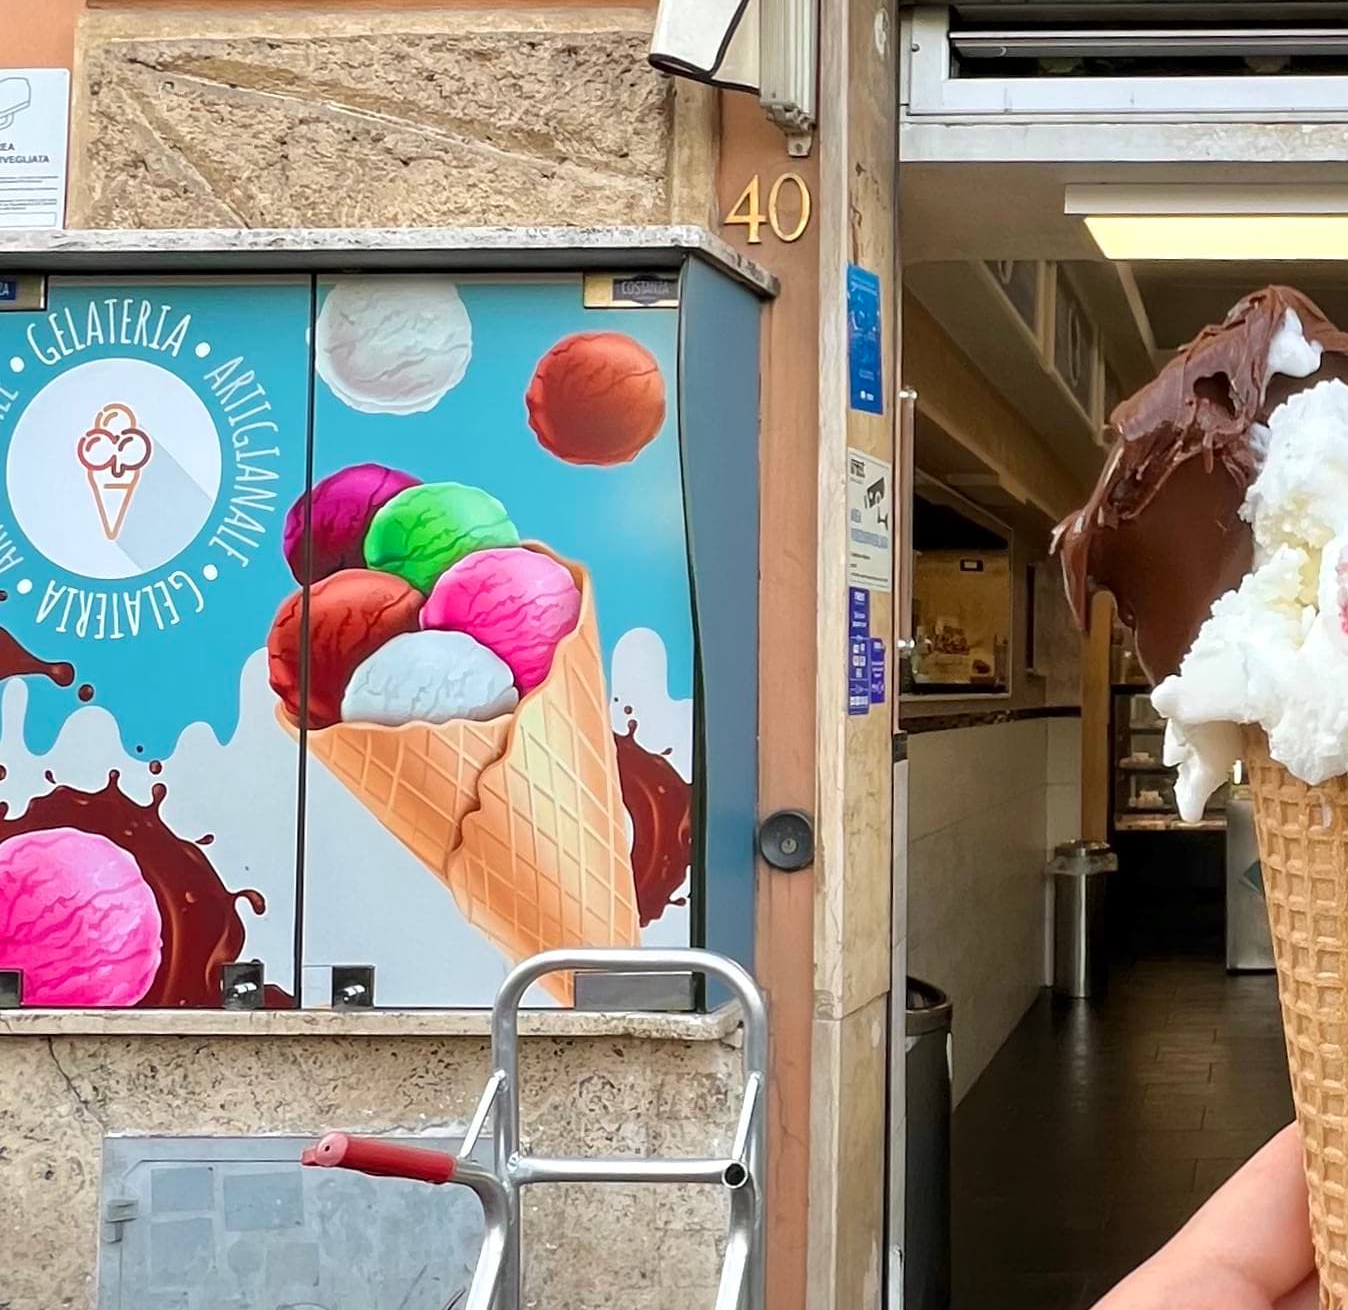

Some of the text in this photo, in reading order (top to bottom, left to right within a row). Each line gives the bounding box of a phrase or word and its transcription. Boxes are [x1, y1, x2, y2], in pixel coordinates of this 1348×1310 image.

[0, 142, 15, 151] EA
[723, 173, 811, 244] 40
[621, 280, 670, 295] COSTANZA
[26, 297, 192, 367] GELATERIA
[203, 354, 281, 569] ARTIGIANALE
[35, 569, 205, 641] GELATERIA
